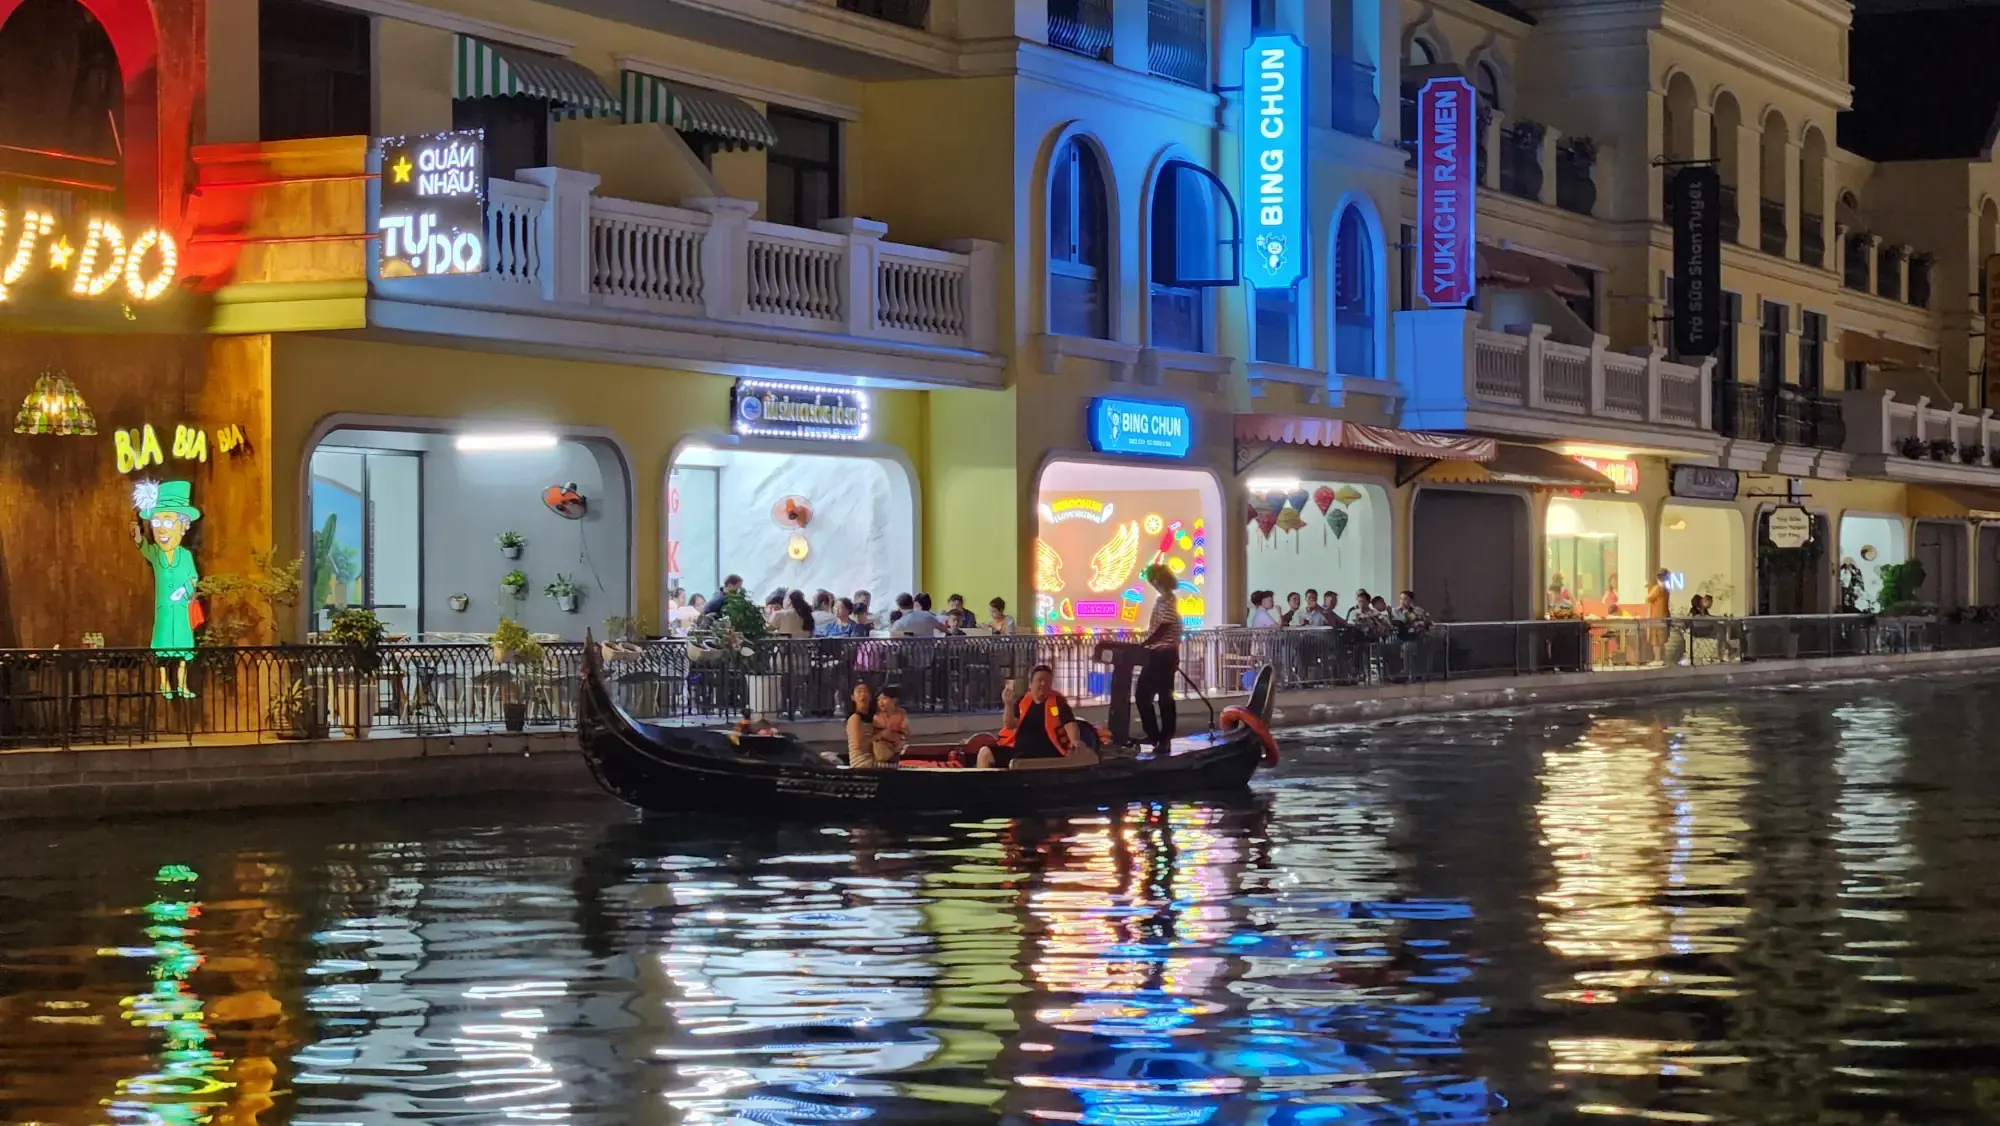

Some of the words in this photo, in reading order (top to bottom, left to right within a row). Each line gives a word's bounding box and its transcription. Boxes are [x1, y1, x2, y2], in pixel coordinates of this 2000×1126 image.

[1260, 48, 1285, 139] CHUN
[1434, 90, 1458, 182] RAMEN
[418, 169, 474, 196] NHẬU
[1260, 149, 1285, 226] BING
[72, 219, 178, 301] DO
[379, 213, 437, 268] TỰ
[427, 232, 482, 274] DO
[1434, 188, 1457, 294] YUKICHI
[115, 424, 163, 473] BIA
[172, 424, 207, 462] BIA
[217, 423, 244, 453] BIA
[1121, 412, 1149, 434] BING
[1151, 415, 1182, 437] CHUN
